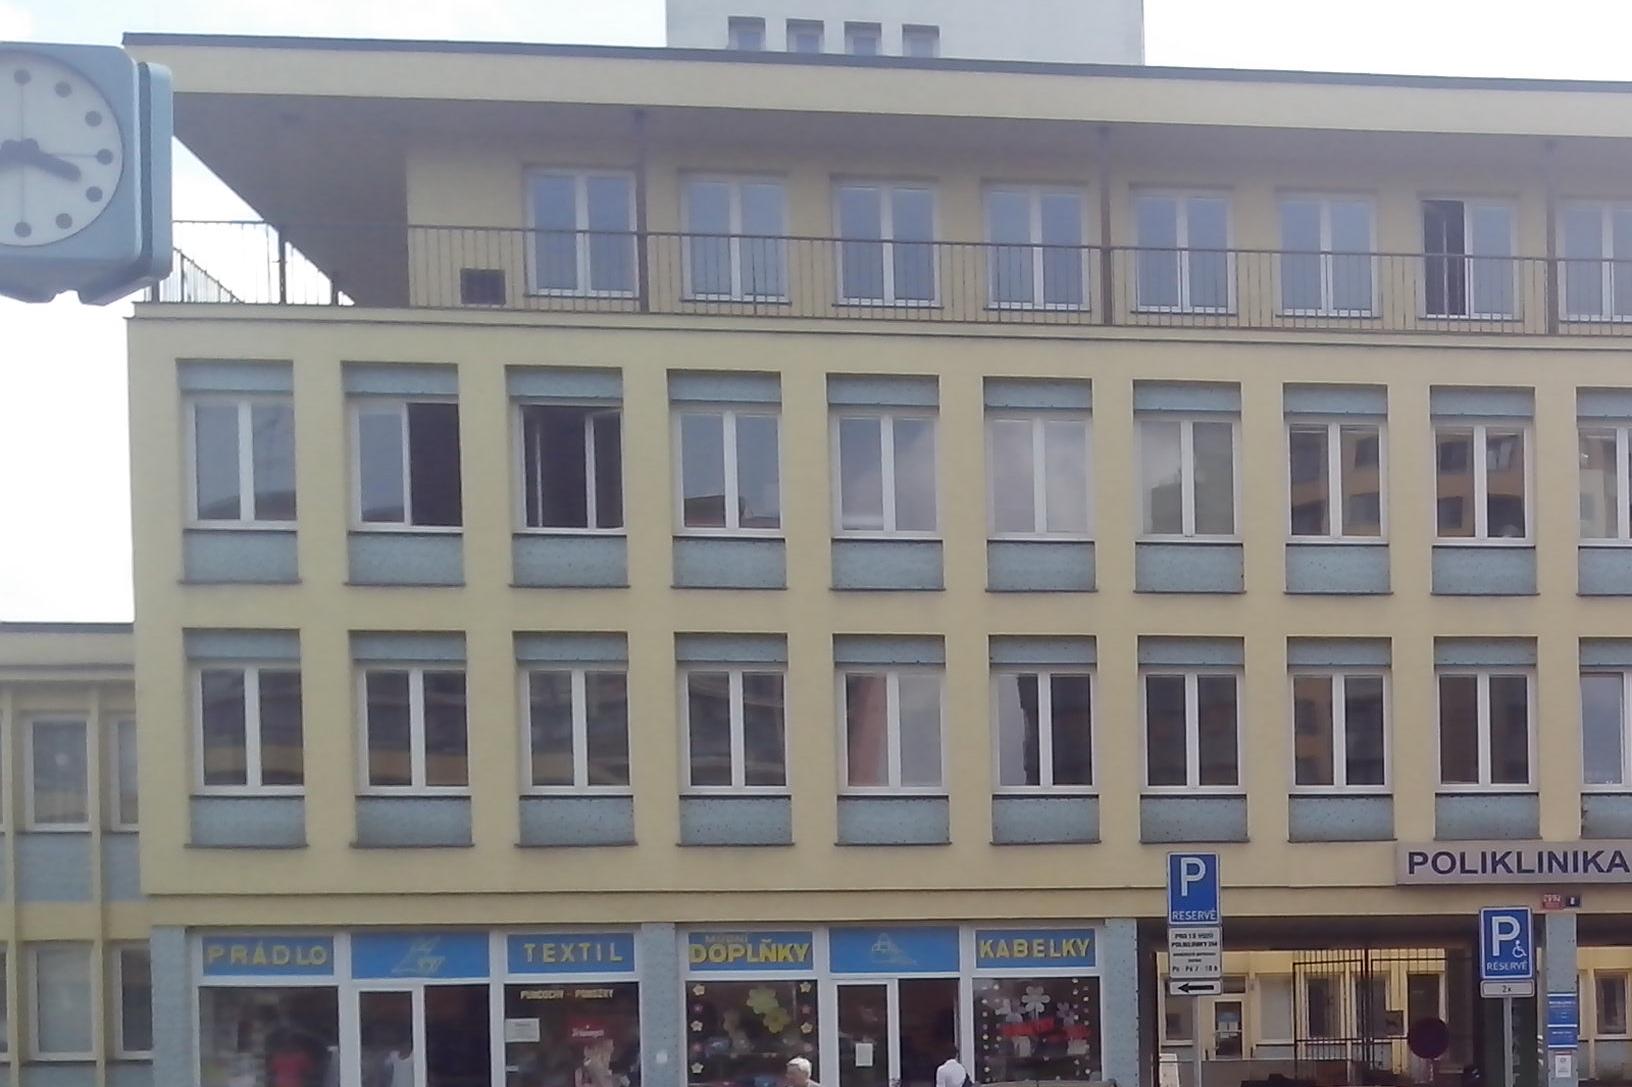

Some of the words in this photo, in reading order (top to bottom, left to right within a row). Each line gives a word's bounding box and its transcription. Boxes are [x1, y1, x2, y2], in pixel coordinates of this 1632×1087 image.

[1408, 850, 1630, 875] POLIKLINIKA
[1180, 857, 1206, 897] P
[1172, 907, 1217, 921] RESERVÉ
[979, 938, 1090, 958] KABELKY
[1492, 915, 1521, 957] P
[206, 940, 328, 966] PRÁDLO
[523, 942, 624, 963] TEXTIL
[688, 937, 810, 964] DOPLŇKY
[1486, 960, 1528, 971] RESERVÉ
